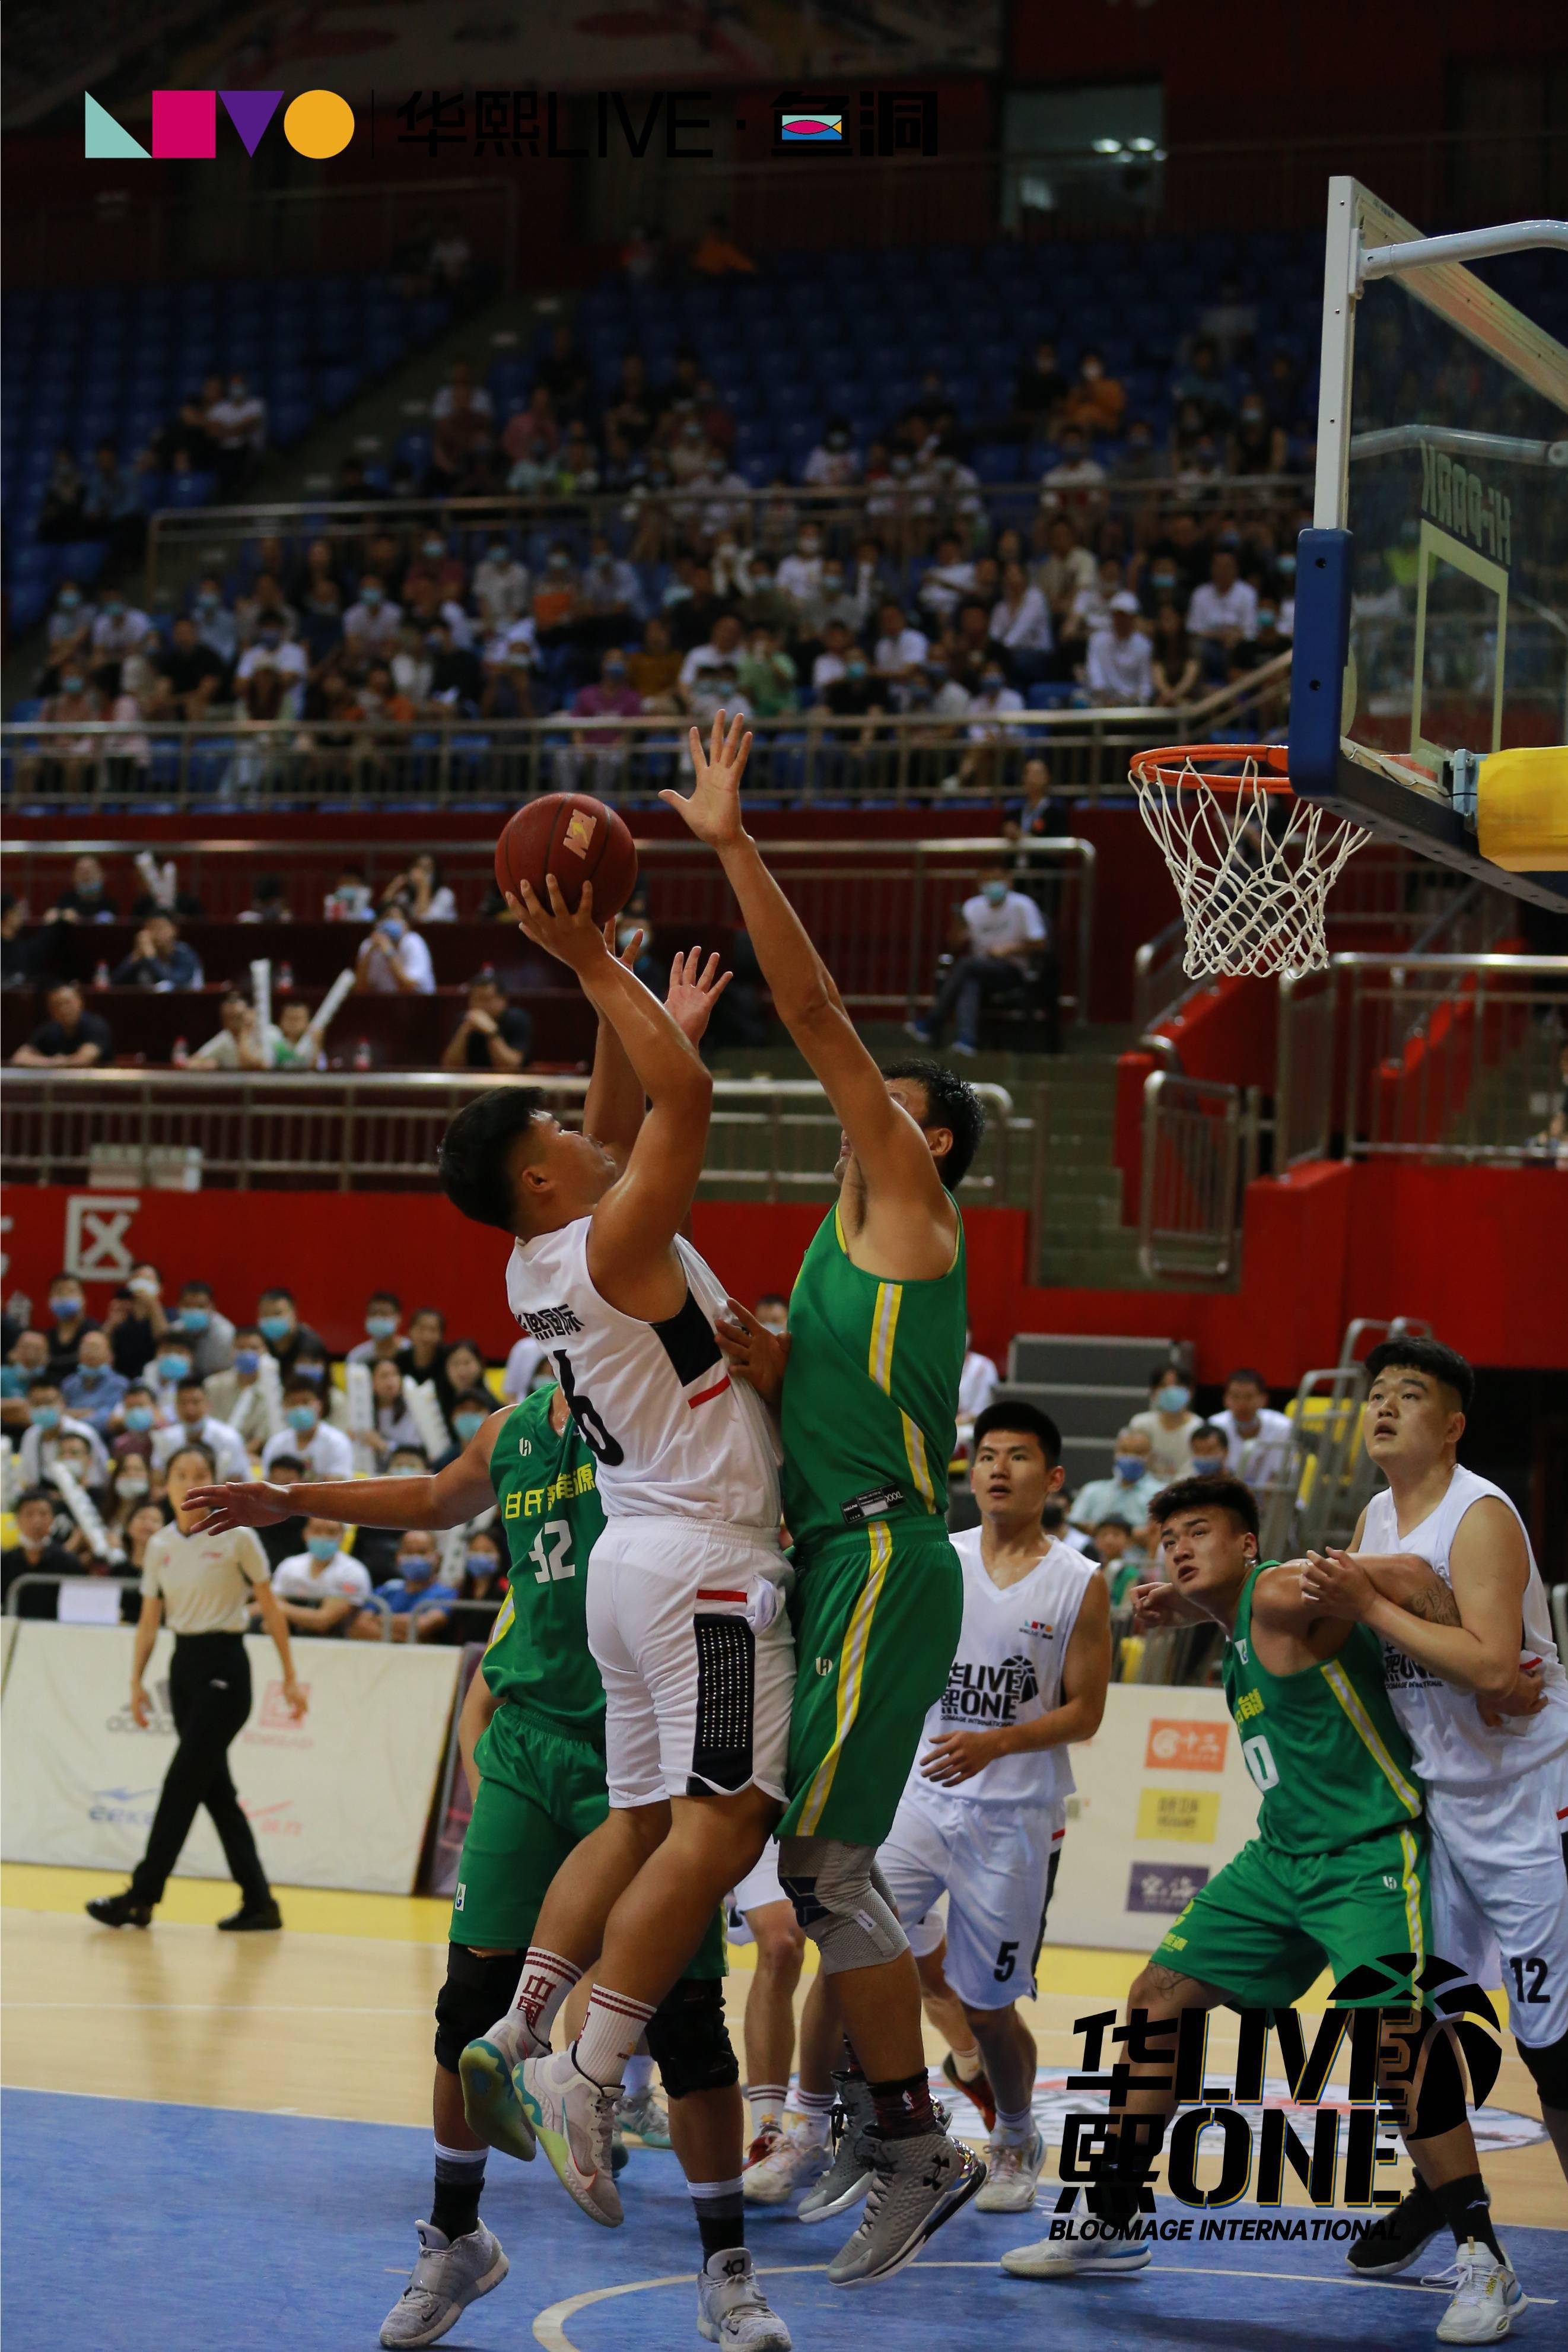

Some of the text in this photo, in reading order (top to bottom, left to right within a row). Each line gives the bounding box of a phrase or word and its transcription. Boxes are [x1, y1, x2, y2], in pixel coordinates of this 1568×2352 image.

[885, 1491, 904, 1503] XXXL
[528, 1520, 575, 1584] 32
[962, 1664, 1024, 1694] LIVE
[960, 1689, 1020, 1719] ONE
[994, 1941, 1019, 1982] 5
[1510, 1957, 1550, 2004] 12
